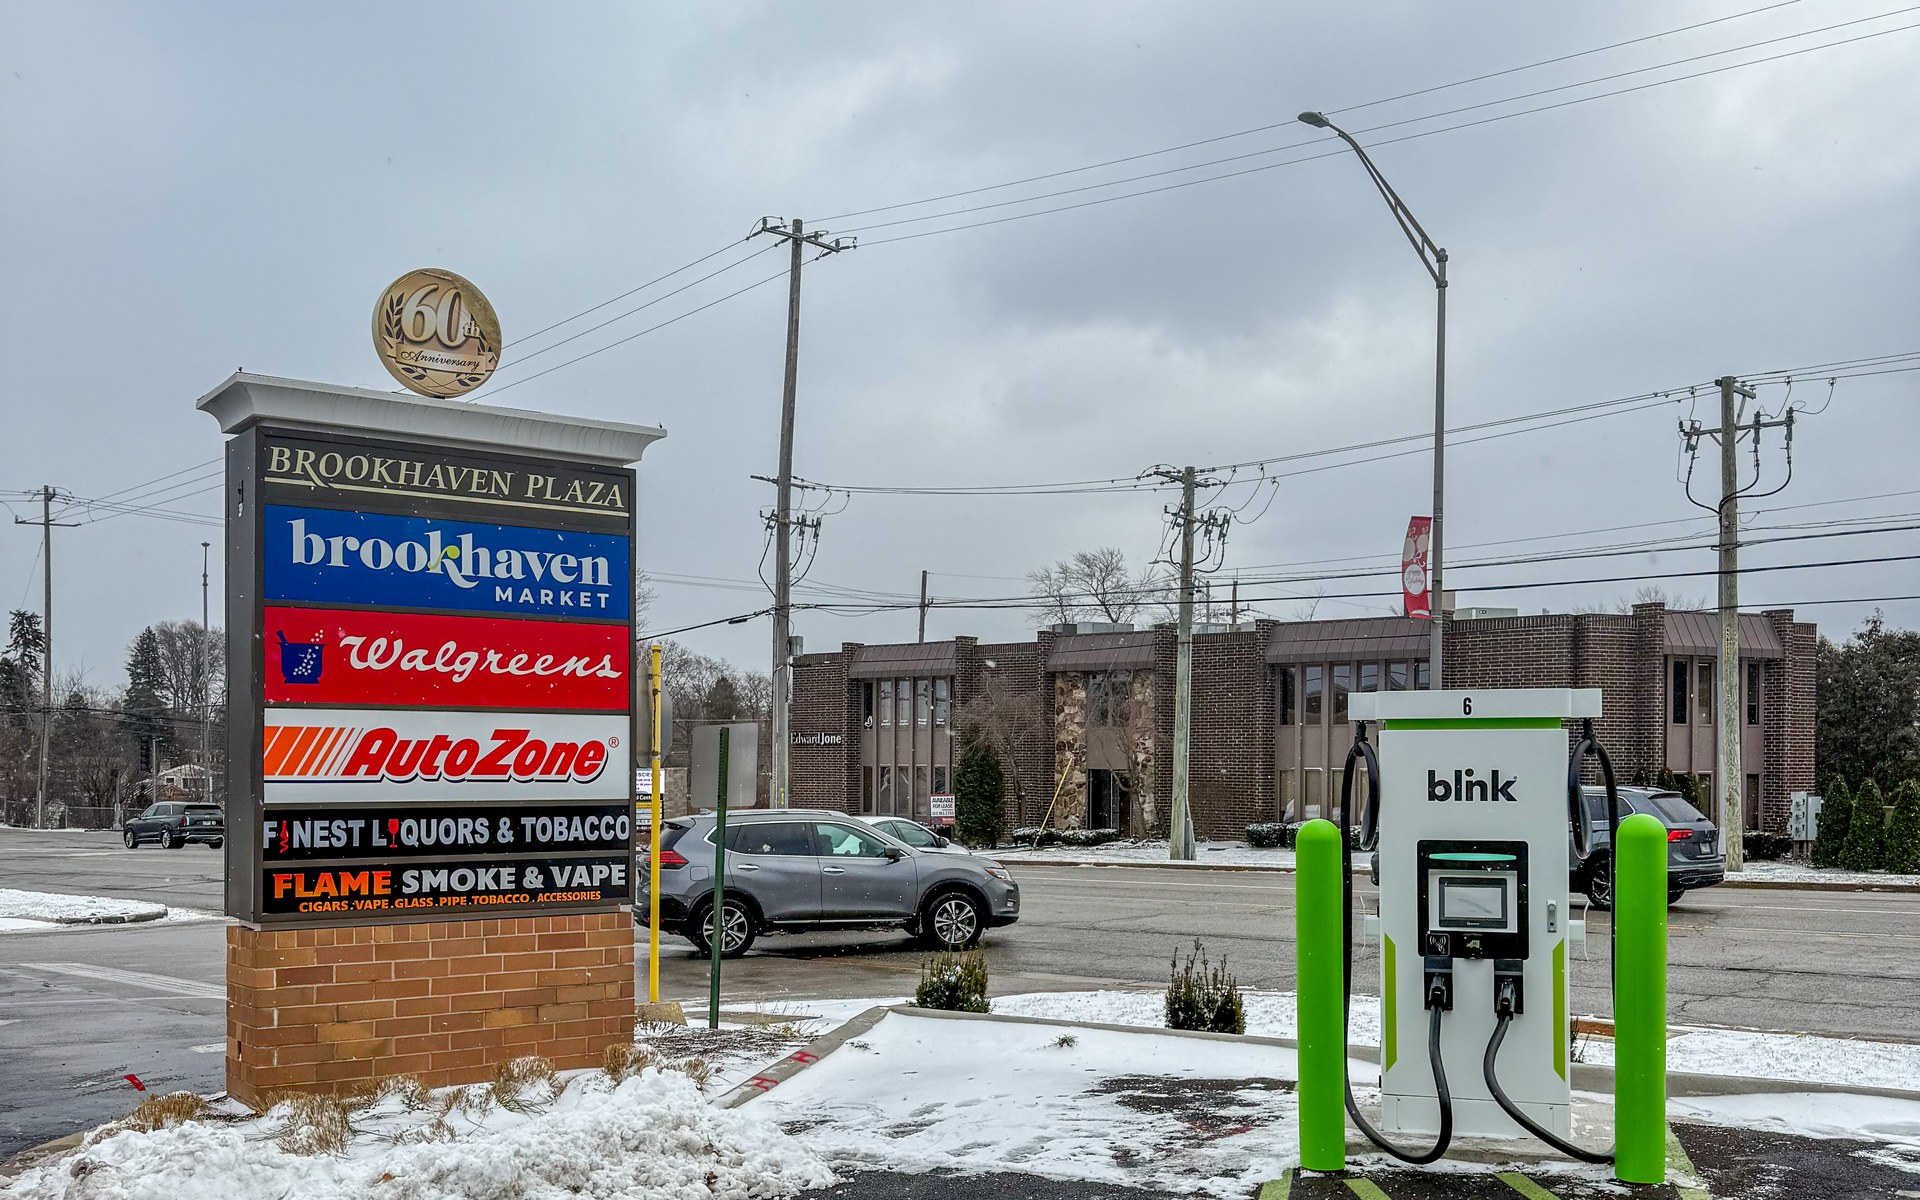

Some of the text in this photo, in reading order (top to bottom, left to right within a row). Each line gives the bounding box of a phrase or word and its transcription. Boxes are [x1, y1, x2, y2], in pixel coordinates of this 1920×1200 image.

[400, 350, 480, 372] Anniversary
[266, 446, 625, 508] BROOKHAVEN PLAZA
[287, 518, 612, 588] brookhaven
[495, 586, 609, 608] MARKET
[339, 635, 622, 683] Walgreens
[1462, 697, 1472, 715] 6
[341, 727, 609, 784] AutoZone
[1427, 768, 1518, 802] blink
[496, 817, 515, 843] &
[520, 815, 630, 843] TOBACCO
[272, 864, 626, 899] FLAME SMOKE & VAPE
[537, 890, 601, 903] ACCESSORIES
